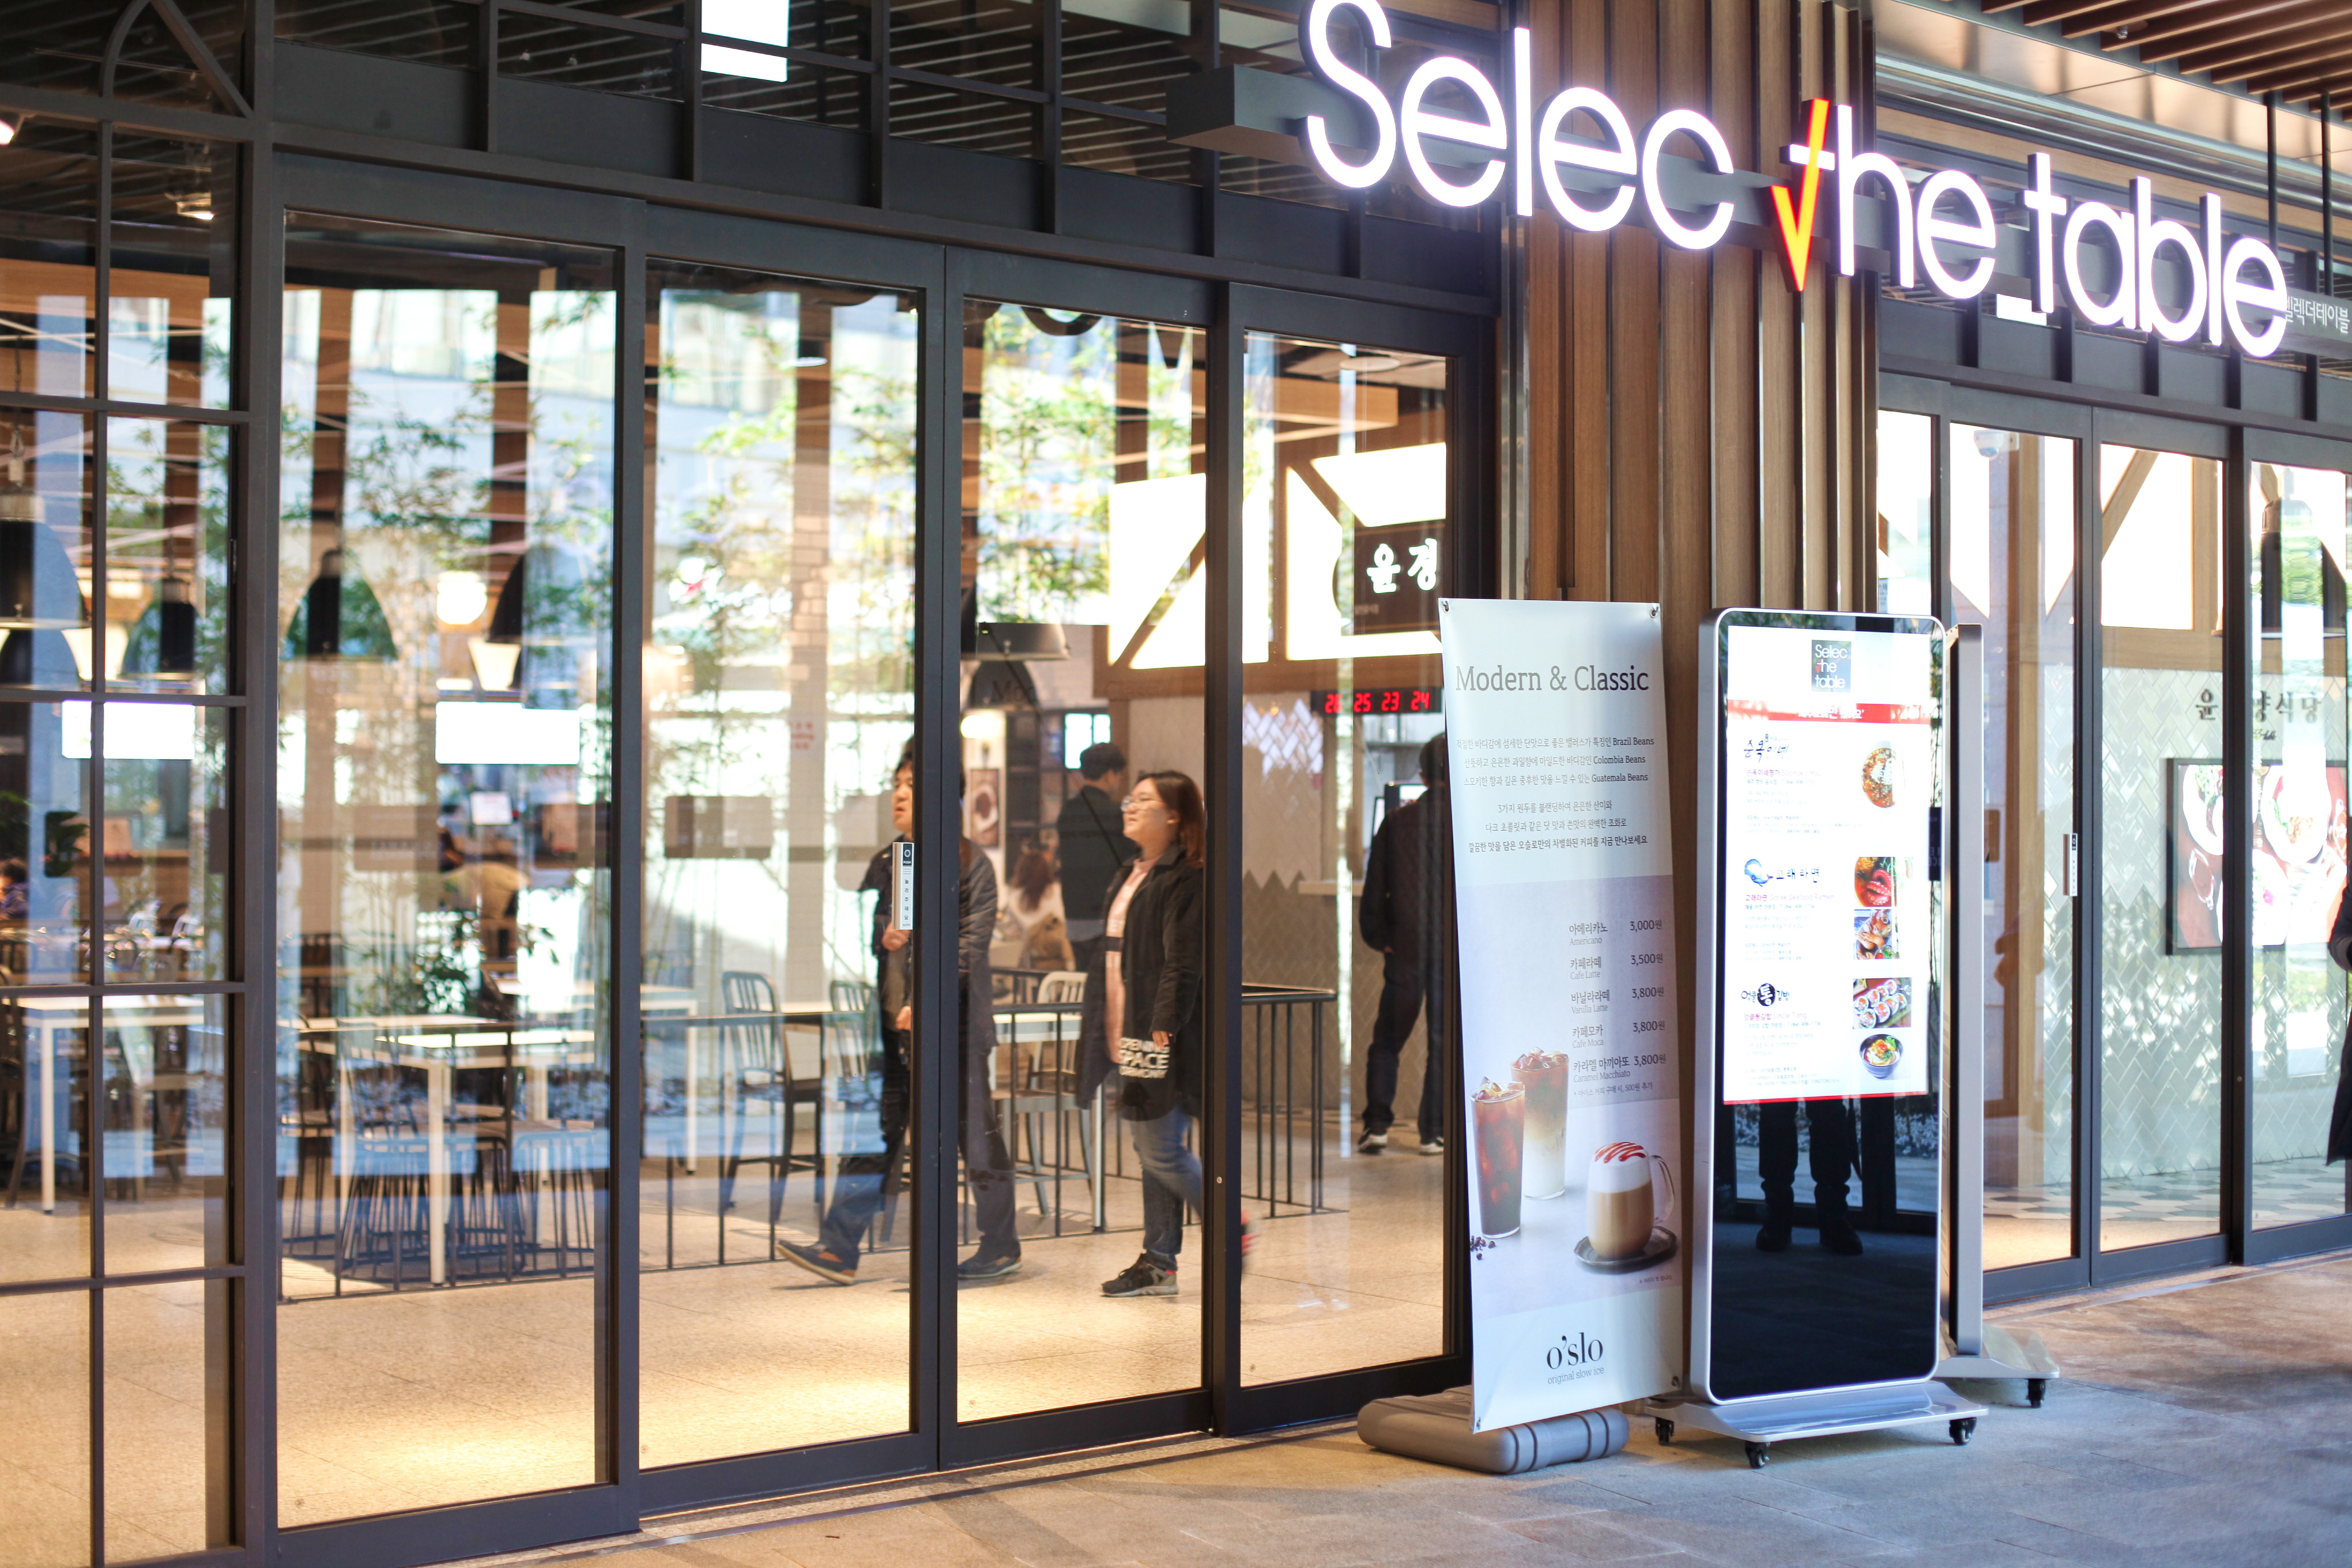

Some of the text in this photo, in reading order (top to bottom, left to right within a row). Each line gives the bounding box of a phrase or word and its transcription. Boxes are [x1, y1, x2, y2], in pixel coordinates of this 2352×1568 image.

[1308, 0, 1734, 250] Selec
[2025, 152, 2287, 357] table
[1815, 644, 1848, 658] Selec
[1456, 664, 1649, 691] Modern & Classic
[1815, 674, 1846, 689] table
[1325, 691, 1430, 713] 26 25 23 24
[2195, 689, 2322, 723] 윤양식당
[1475, 738, 1501, 749] 바디감에
[1503, 738, 1522, 749] 섬세한
[1524, 738, 1550, 749] 단맛으로
[1552, 738, 1564, 748] 좋은
[1593, 737, 1611, 747] 특징인
[1612, 737, 1631, 745] Brazil
[1633, 737, 1654, 745] Beans
[1491, 757, 1510, 768] 은은한
[1512, 756, 1538, 767] 과일향에
[1540, 756, 1566, 767] 마일드한
[1567, 755, 1592, 766] 바디감인
[1593, 755, 1624, 764] Colombia
[1625, 755, 1646, 763] Beans
[1464, 776, 1488, 786] 스모키한
[1490, 775, 1502, 786] 향과
[1504, 775, 1518, 786] 깊은
[1540, 774, 1554, 785] 맛을
[1555, 774, 1568, 785] 느낄
[1569, 774, 1576, 784] 수
[1577, 774, 1590, 784] 있는
[1592, 773, 1626, 782] Guatemala
[1627, 773, 1649, 781] Beans
[1498, 804, 1515, 813] 3가지
[1517, 803, 1537, 813] 원두를
[1573, 801, 1592, 812] 은은한
[1593, 800, 1612, 811] 산미와
[1486, 823, 1499, 833] 다크
[1528, 821, 1542, 831] 같은
[1552, 820, 1566, 831] 맛과
[1588, 819, 1607, 829] 완벽한
[1608, 818, 1628, 828] 조화로
[1468, 835, 1649, 853] 깔끔한 맛을 담은 오슬로만의 차별화된 커피를 지금 만나보세요
[1776, 866, 1819, 884] 고래라면
[1569, 919, 1663, 936] 아메리카노 3,000원
[1570, 937, 1603, 946] Americano
[1570, 953, 1664, 970] 카페라떼 3,500원
[1570, 970, 1601, 980] Cafe Latte
[1571, 986, 1664, 1004] 바닐라라떼 3,800원
[1571, 1004, 1608, 1015] Vanilla Latte
[1572, 1020, 1665, 1038] 카페모카 3,800원
[1572, 1038, 1604, 1049] Cafe Moca
[1573, 1053, 1667, 1073] 카라멜 마끼아또 3,800원
[1573, 1069, 1631, 1083] Caramel Macchiato
[1548, 1370, 1574, 1385] original
[1576, 1369, 1592, 1379] slow
